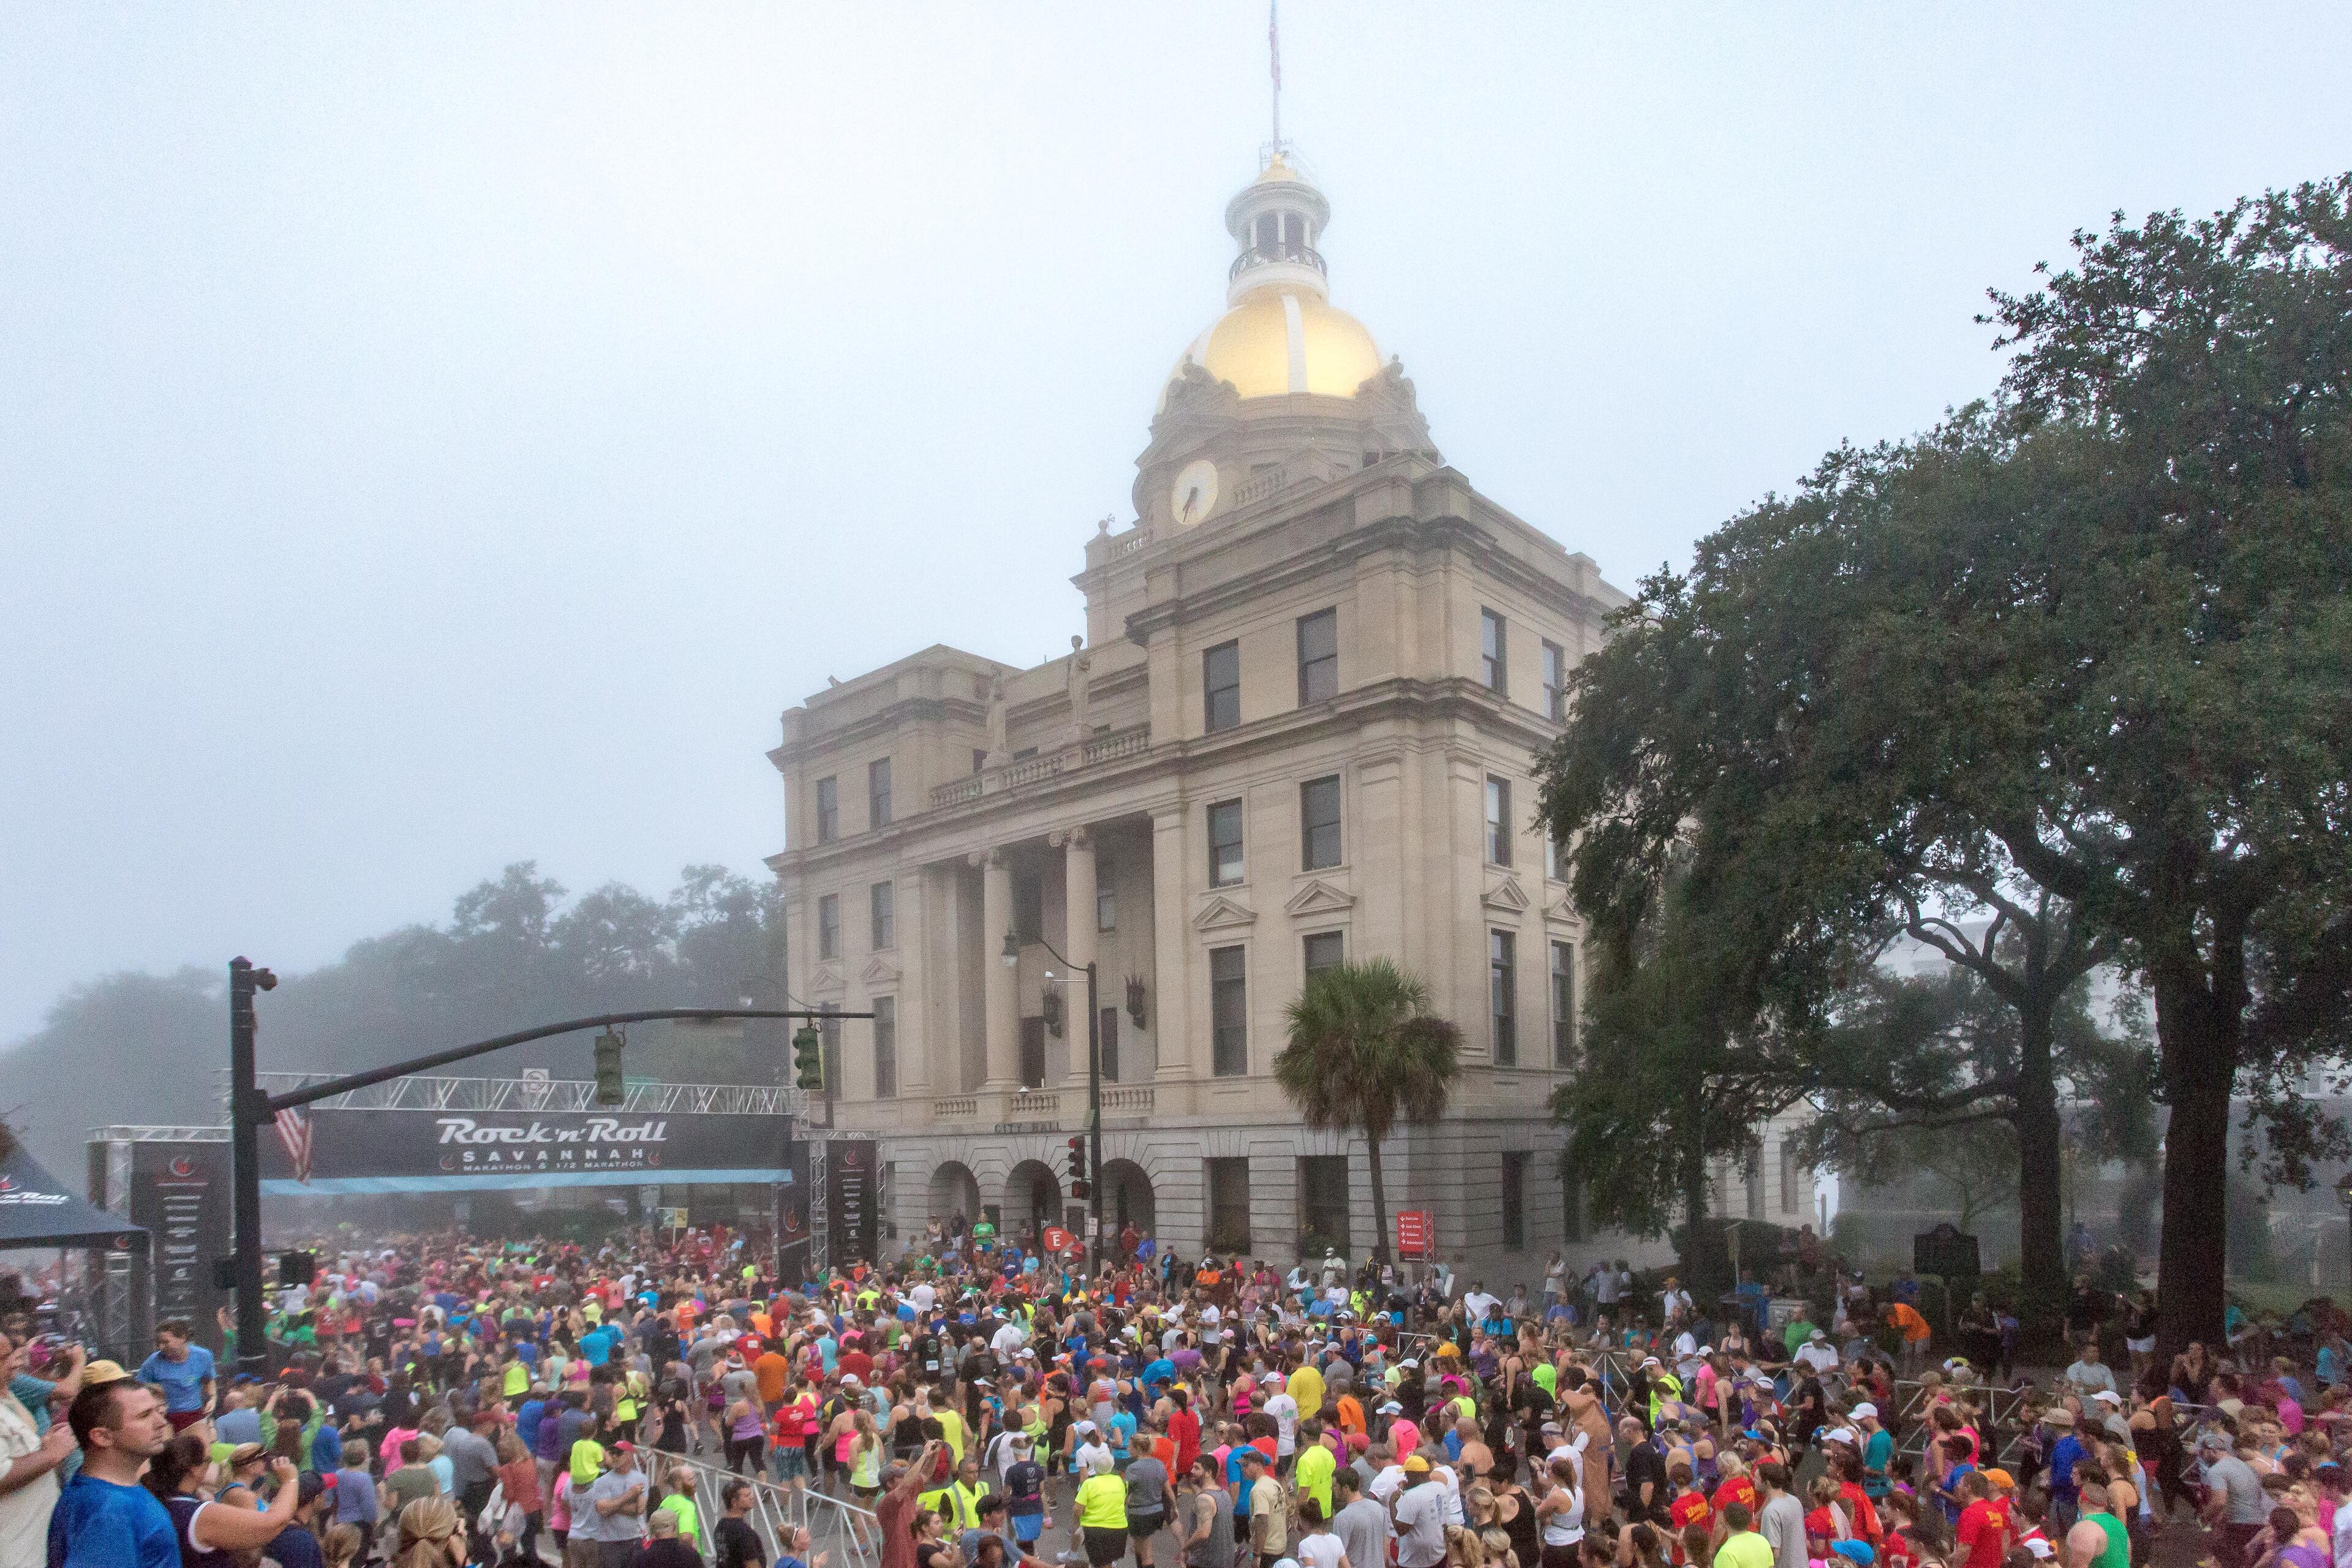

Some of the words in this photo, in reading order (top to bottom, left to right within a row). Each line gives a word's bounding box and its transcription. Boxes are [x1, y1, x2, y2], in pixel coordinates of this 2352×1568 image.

[435, 1118, 553, 1144] Rock
[586, 1118, 668, 1143] Roll
[994, 1123, 1022, 1134] CITY
[1032, 1121, 1061, 1133] HALL
[462, 1148, 644, 1163] SAVANNAH
[1052, 1235, 1061, 1247] E
